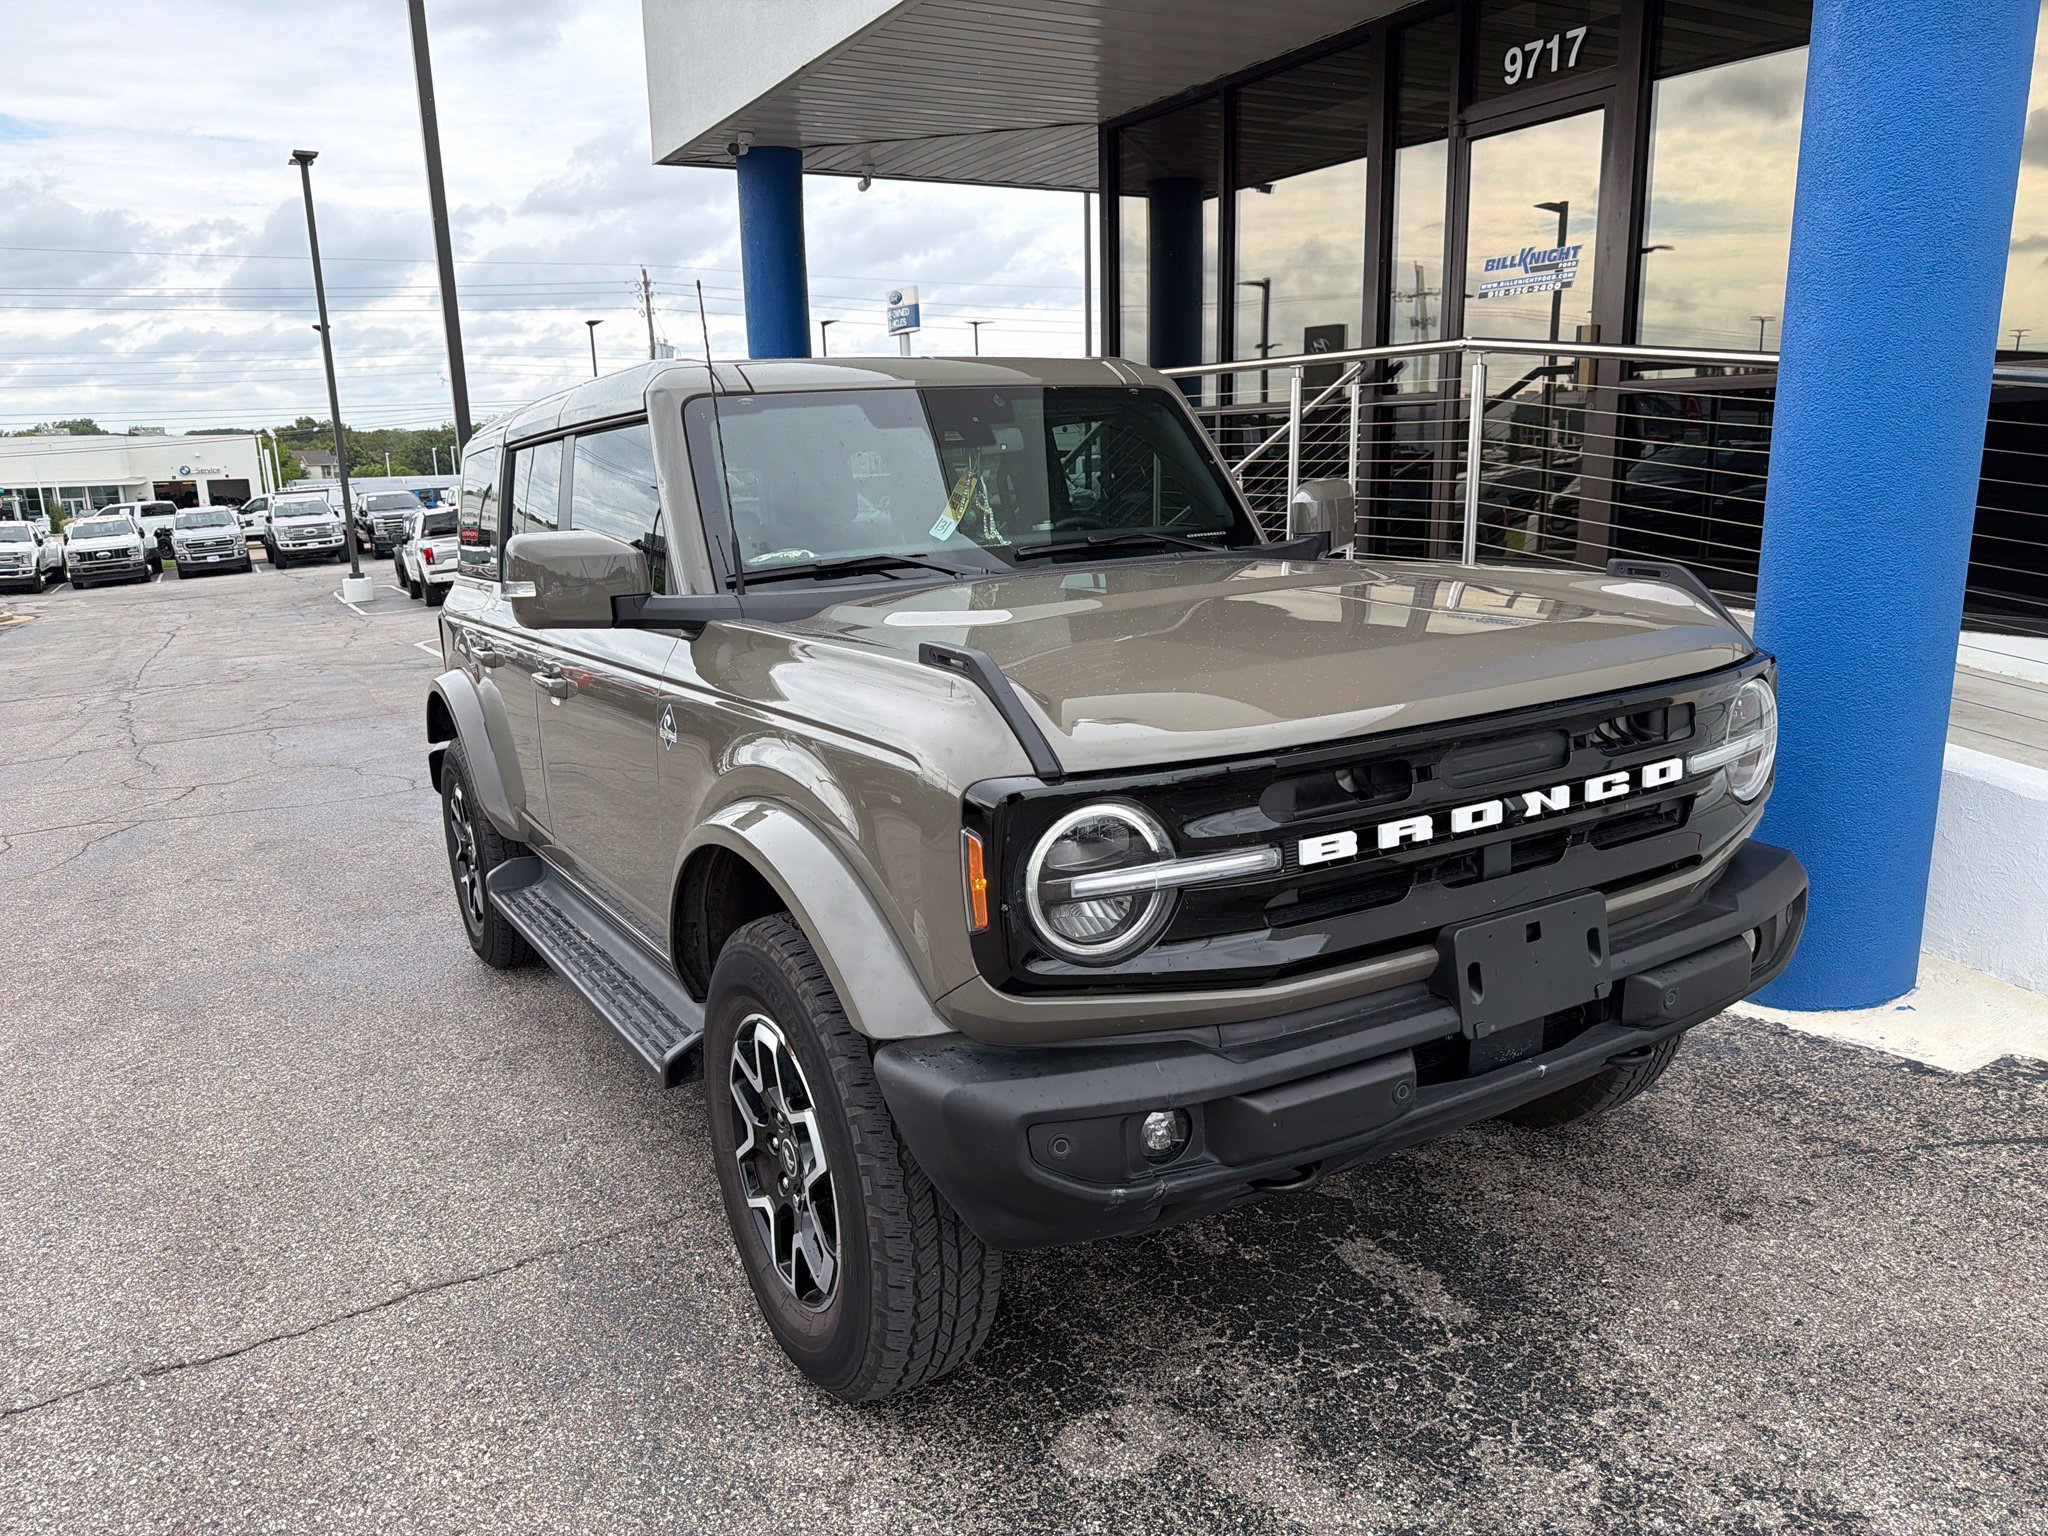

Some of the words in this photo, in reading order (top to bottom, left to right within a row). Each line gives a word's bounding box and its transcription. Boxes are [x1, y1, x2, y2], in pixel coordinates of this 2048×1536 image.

[1504, 25, 1587, 85] 9717
[1558, 261, 1577, 269] FORD
[195, 466, 221, 474] Service
[1298, 757, 1683, 867] BRONCO
